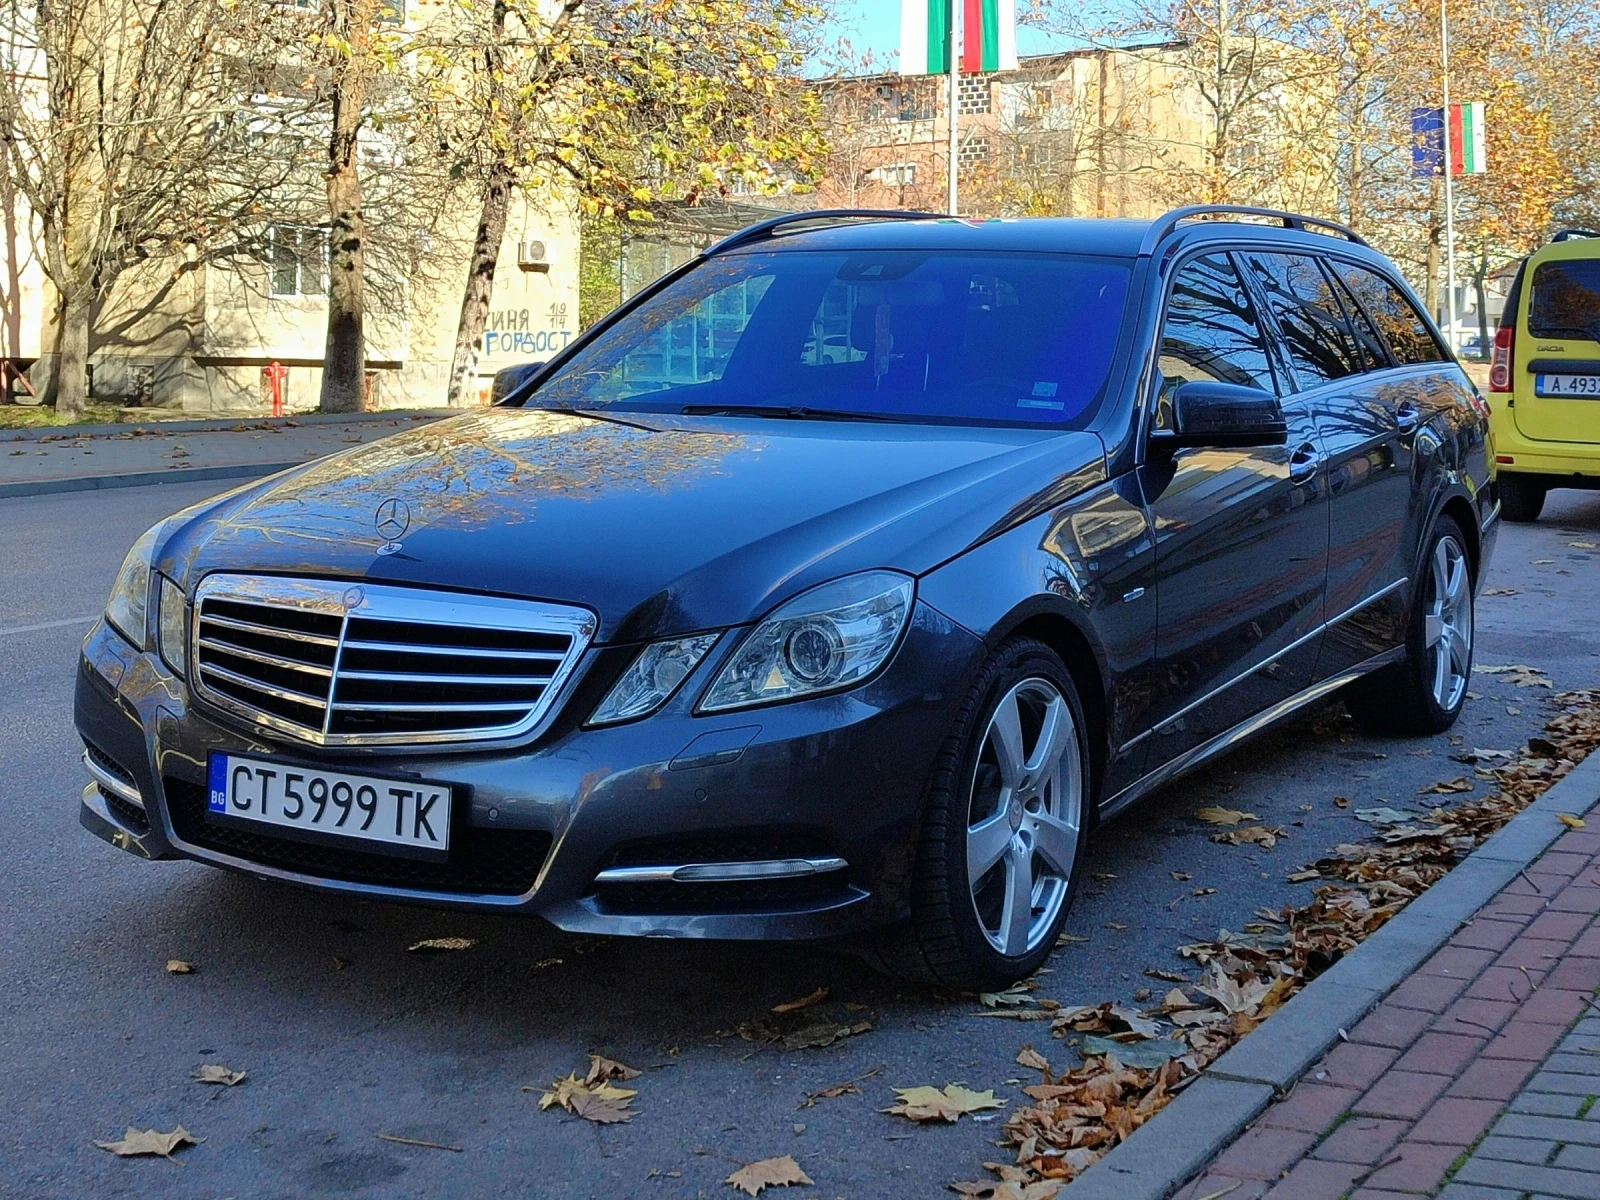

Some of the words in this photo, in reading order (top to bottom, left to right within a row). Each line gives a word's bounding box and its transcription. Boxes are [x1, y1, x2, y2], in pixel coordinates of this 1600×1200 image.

[484, 308, 530, 332] ИНЯ
[1551, 377, 1561, 392] A
[211, 790, 225, 806] BG
[231, 765, 277, 815] CT
[283, 773, 378, 831] 5999
[388, 787, 441, 842] TK
